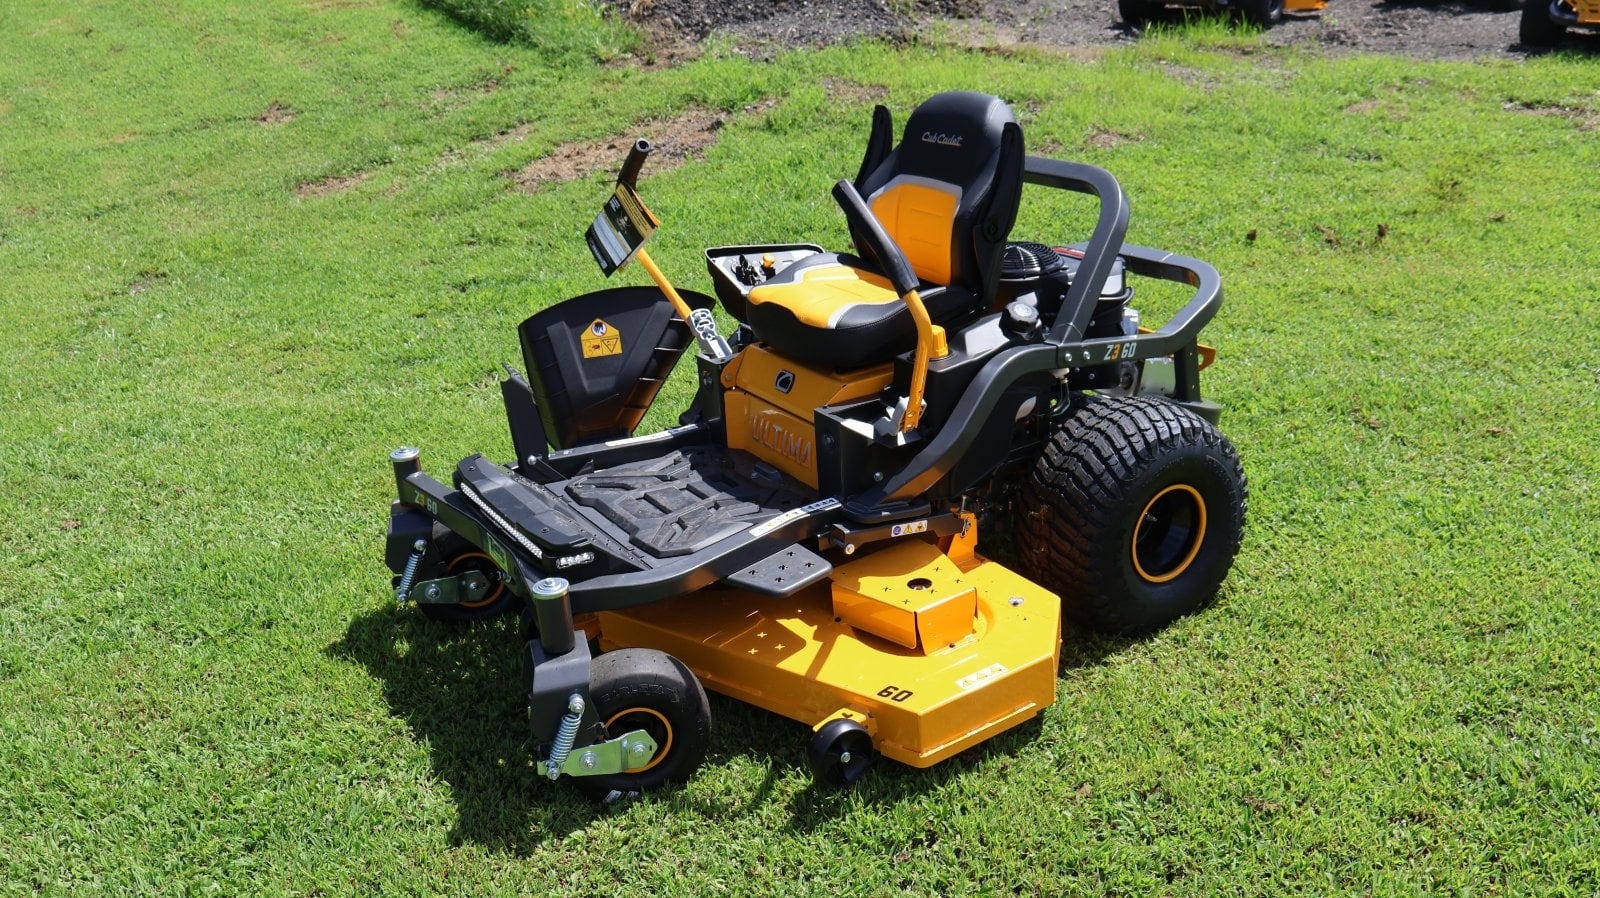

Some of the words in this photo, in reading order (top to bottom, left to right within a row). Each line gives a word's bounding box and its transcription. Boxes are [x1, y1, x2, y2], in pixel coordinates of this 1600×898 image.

[921, 131, 938, 143] Cub
[937, 133, 963, 147] Cadet
[1103, 343, 1121, 360] Z3
[1121, 342, 1137, 359] 60
[752, 415, 812, 471] ULTIMA
[876, 685, 914, 702] 60
